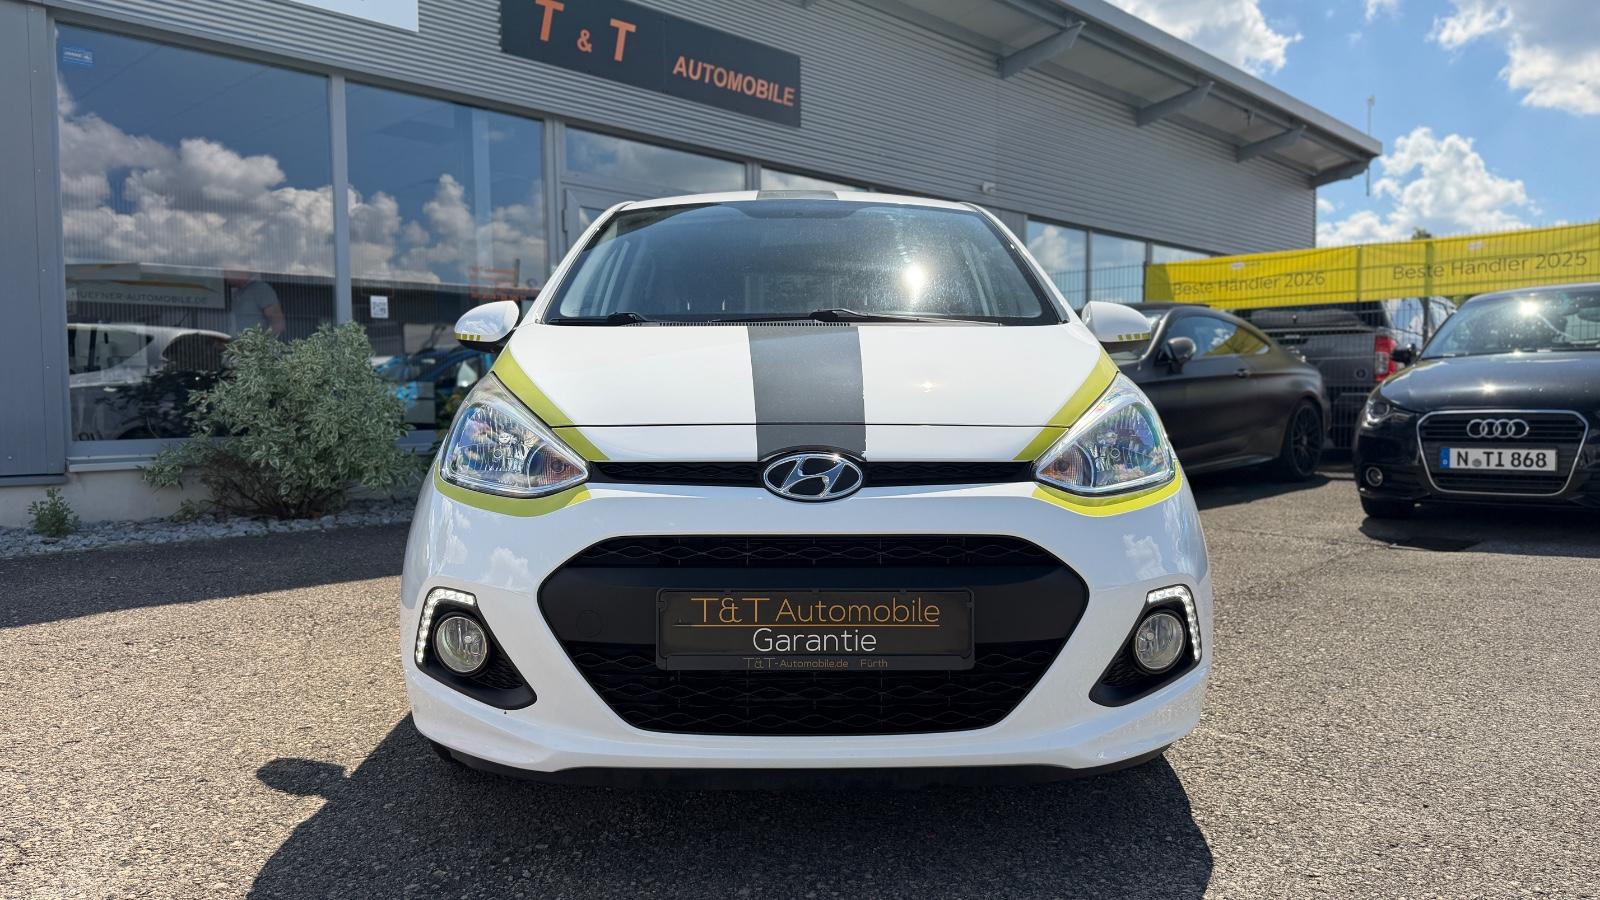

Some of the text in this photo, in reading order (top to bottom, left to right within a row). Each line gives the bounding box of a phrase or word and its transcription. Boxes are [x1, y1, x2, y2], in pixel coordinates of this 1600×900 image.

[534, 0, 796, 107] T & T AUTOMOBILE
[1392, 264, 1445, 280] Beste
[1535, 251, 1588, 270] 2025
[1173, 280, 1214, 296] Beste
[1284, 271, 1326, 288] 2026
[1456, 451, 1547, 469] N TI 868
[691, 597, 941, 624] T&T Automobile
[752, 627, 877, 652] Garantie
[860, 657, 888, 669] Fürth
